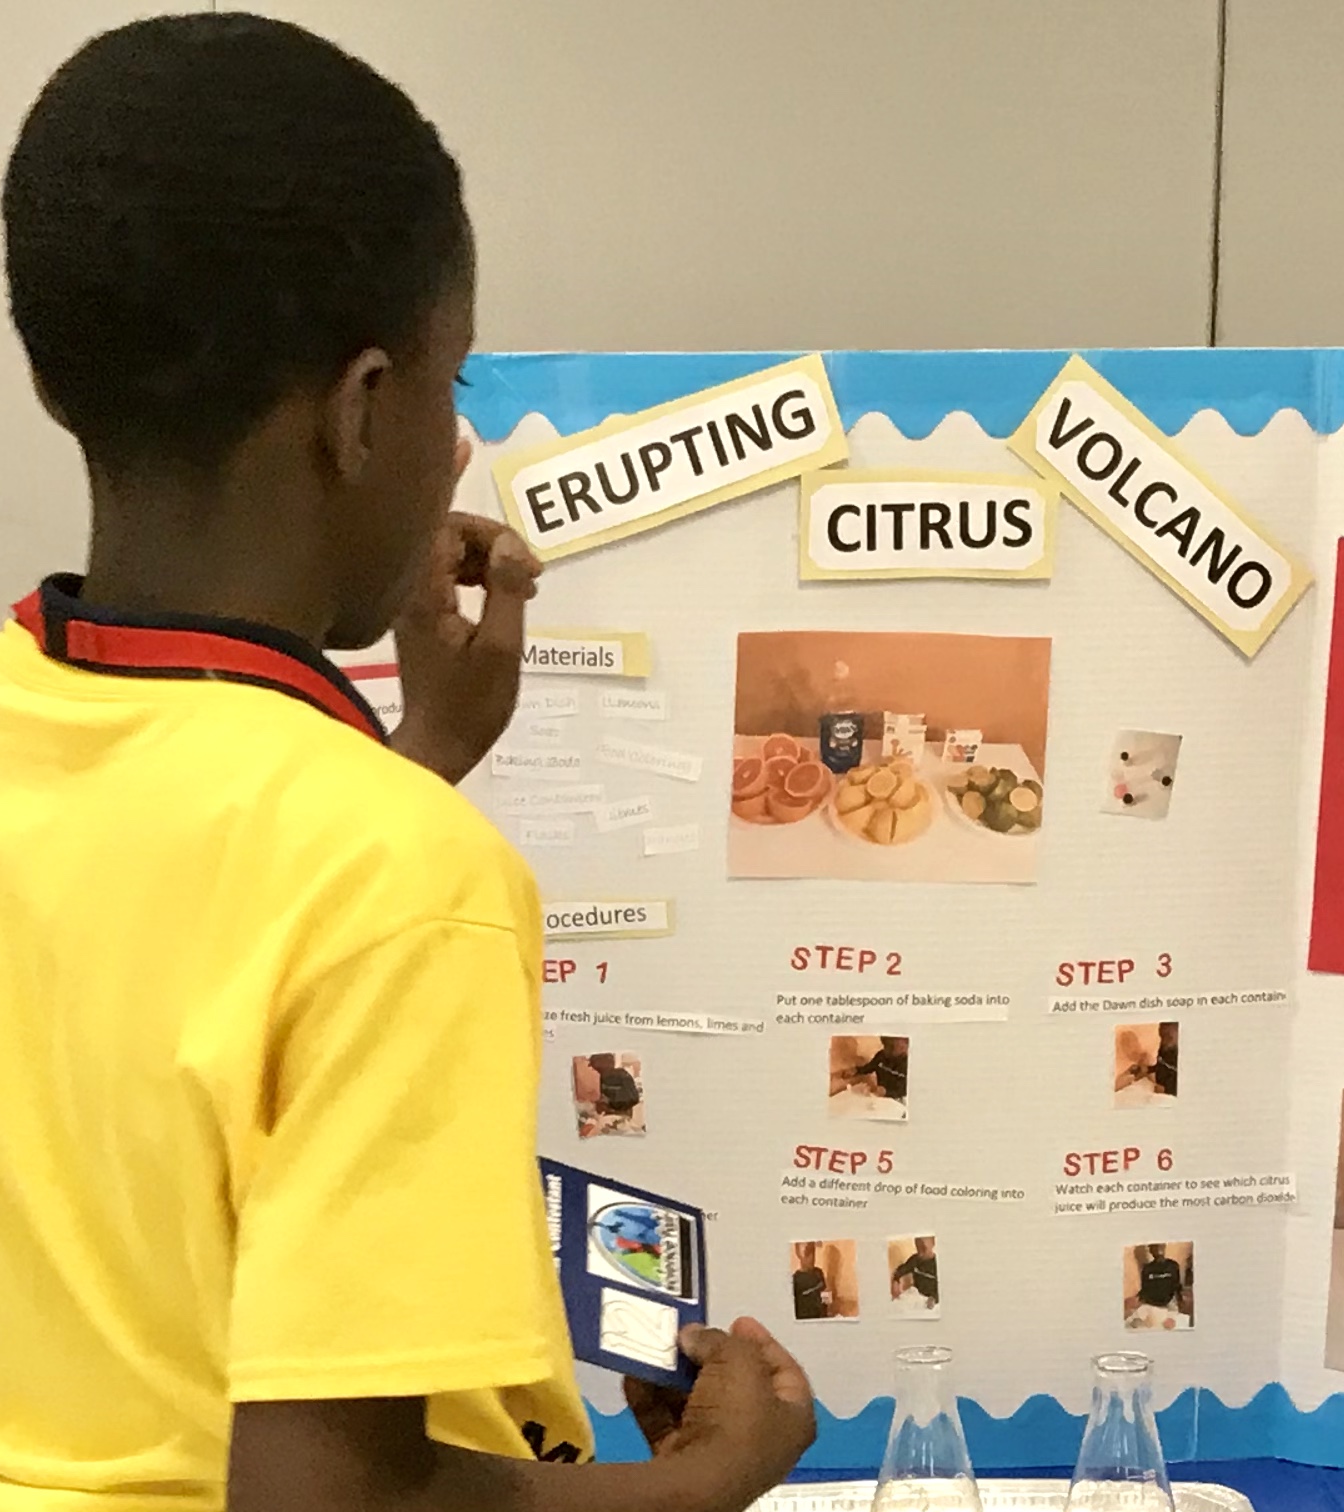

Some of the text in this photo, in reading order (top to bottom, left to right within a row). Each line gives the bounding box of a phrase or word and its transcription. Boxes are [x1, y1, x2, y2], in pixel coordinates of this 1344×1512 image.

[524, 388, 817, 534] ERUPTING
[1046, 397, 1273, 611] VOLCANO
[826, 499, 1034, 554] CITRUS
[521, 645, 614, 667] Materials
[546, 904, 647, 929] ocedures
[543, 958, 608, 983] EP 1
[791, 945, 901, 975] STEP 2
[1056, 953, 1172, 987] STEP 3
[777, 994, 1010, 1007] Put one tablespoon of baking soda into
[1052, 1001, 1077, 1012] Add
[1080, 1001, 1099, 1011] the
[1103, 999, 1136, 1010] Dawn
[1139, 997, 1163, 1008] dish
[1167, 998, 1194, 1009] soap
[1197, 996, 1207, 1006] in
[1211, 993, 1238, 1005] each
[560, 1010, 591, 1023] fresh
[593, 1012, 621, 1025] juice
[625, 1014, 653, 1025] from
[656, 1015, 702, 1029] lemons,
[707, 1018, 738, 1031] limes
[741, 1021, 763, 1033] and
[776, 1013, 865, 1024] each container
[793, 1145, 894, 1174] STEP 5
[1064, 1147, 1173, 1176] STEP 6
[782, 1176, 1025, 1200] Add a different drop of food coloring into
[1056, 1175, 1290, 1194] Watch each container to see which citrus
[781, 1194, 868, 1208] each container
[1055, 1192, 1295, 1214] juice will produce the most carbon dioxide
